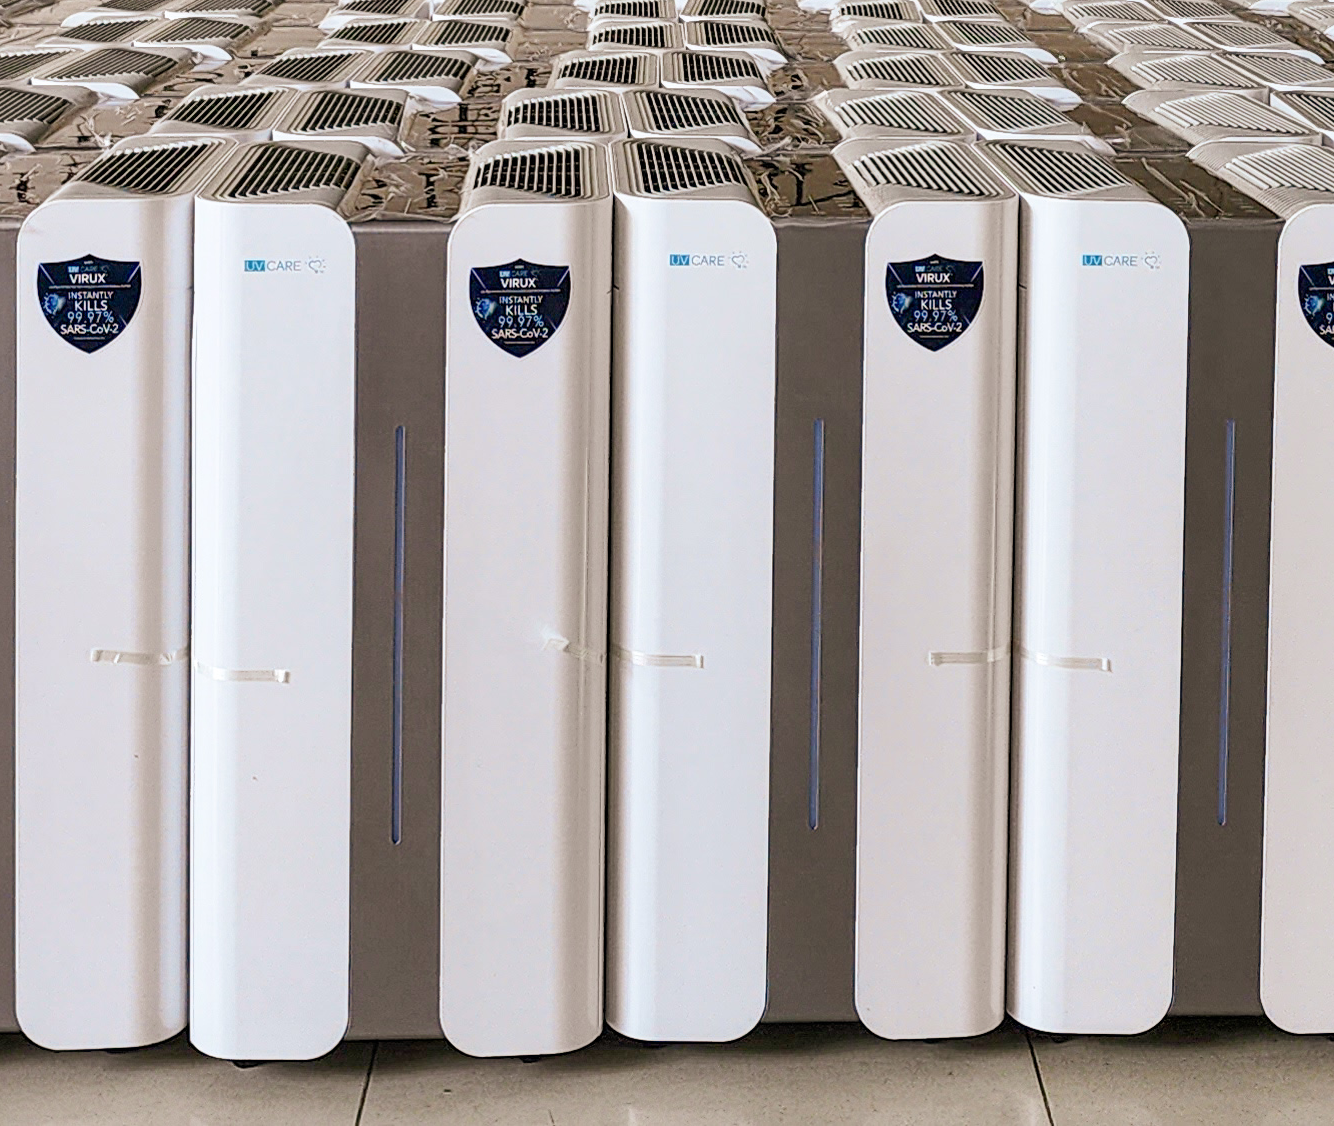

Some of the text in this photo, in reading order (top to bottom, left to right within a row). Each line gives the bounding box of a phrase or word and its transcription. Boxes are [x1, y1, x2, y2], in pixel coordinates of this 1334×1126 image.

[245, 260, 301, 271] UV CARE
[670, 254, 725, 266] UV CARE
[1083, 255, 1137, 266] UV CARE
[69, 273, 106, 284] VIRUX
[500, 278, 536, 288] VIRUX
[916, 273, 950, 283] VIRUX
[68, 291, 113, 299] INSTANTLY
[499, 296, 543, 304] INSTANTLY
[75, 300, 108, 311] KILLS
[506, 304, 537, 316] KILLS
[921, 299, 952, 310] KILLS
[68, 311, 114, 323] 99.97%
[498, 315, 544, 327] 99.97%
[61, 324, 118, 334] SARS-CoV-2
[492, 328, 548, 339] SARS-CoV-2
[907, 323, 962, 333] SARS-CoV-2
